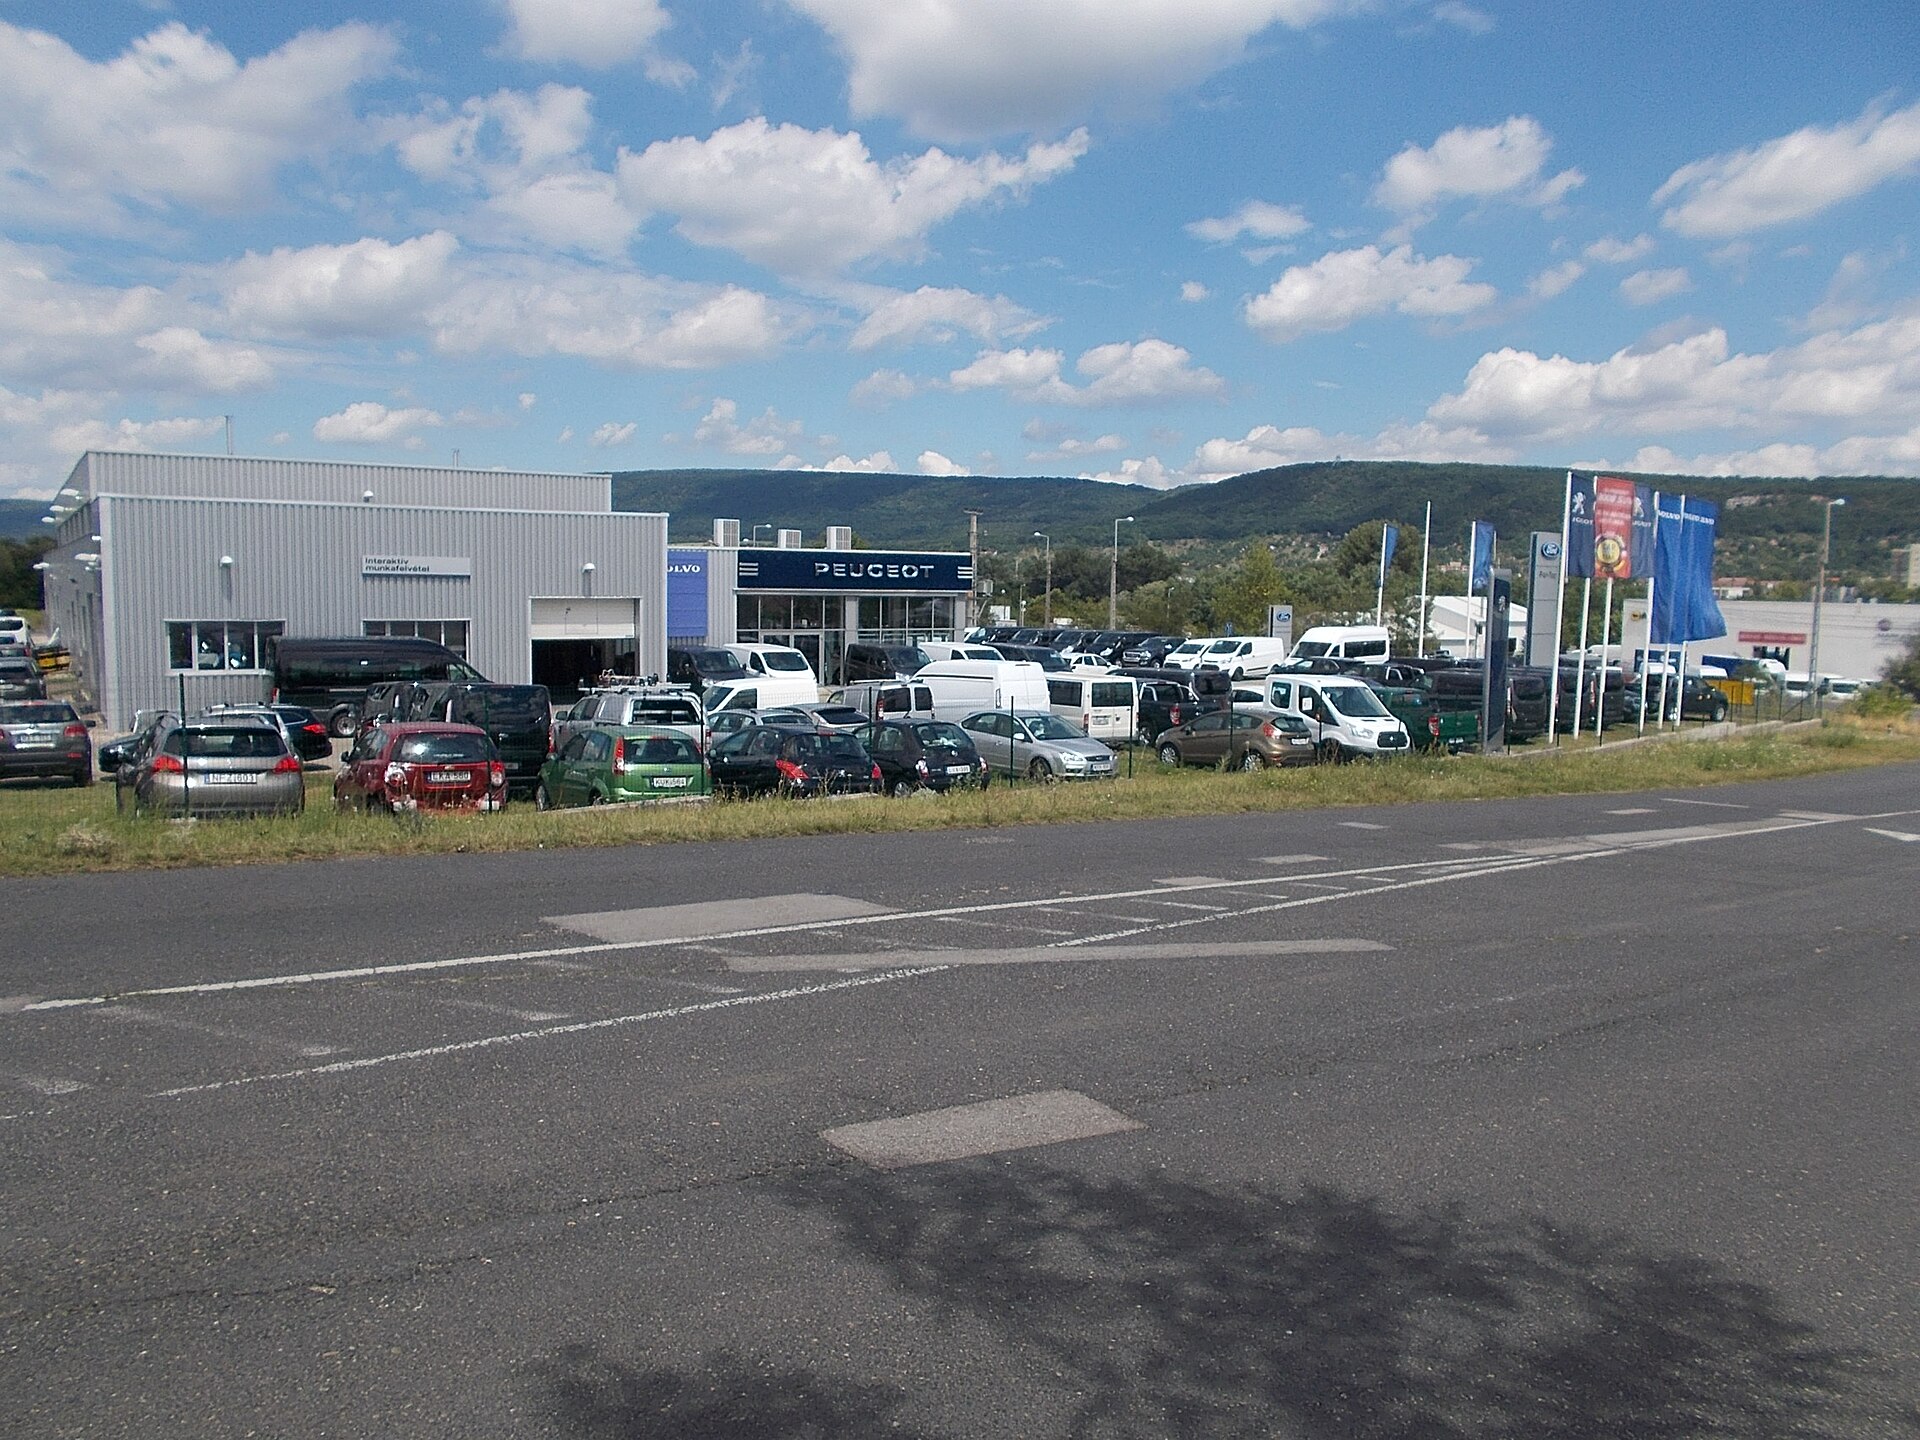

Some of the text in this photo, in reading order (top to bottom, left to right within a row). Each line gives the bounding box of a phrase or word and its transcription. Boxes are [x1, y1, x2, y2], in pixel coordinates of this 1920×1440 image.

[365, 557, 409, 565] Interaktiv
[667, 564, 701, 573] OLVO
[814, 562, 935, 578] PEUGEOT
